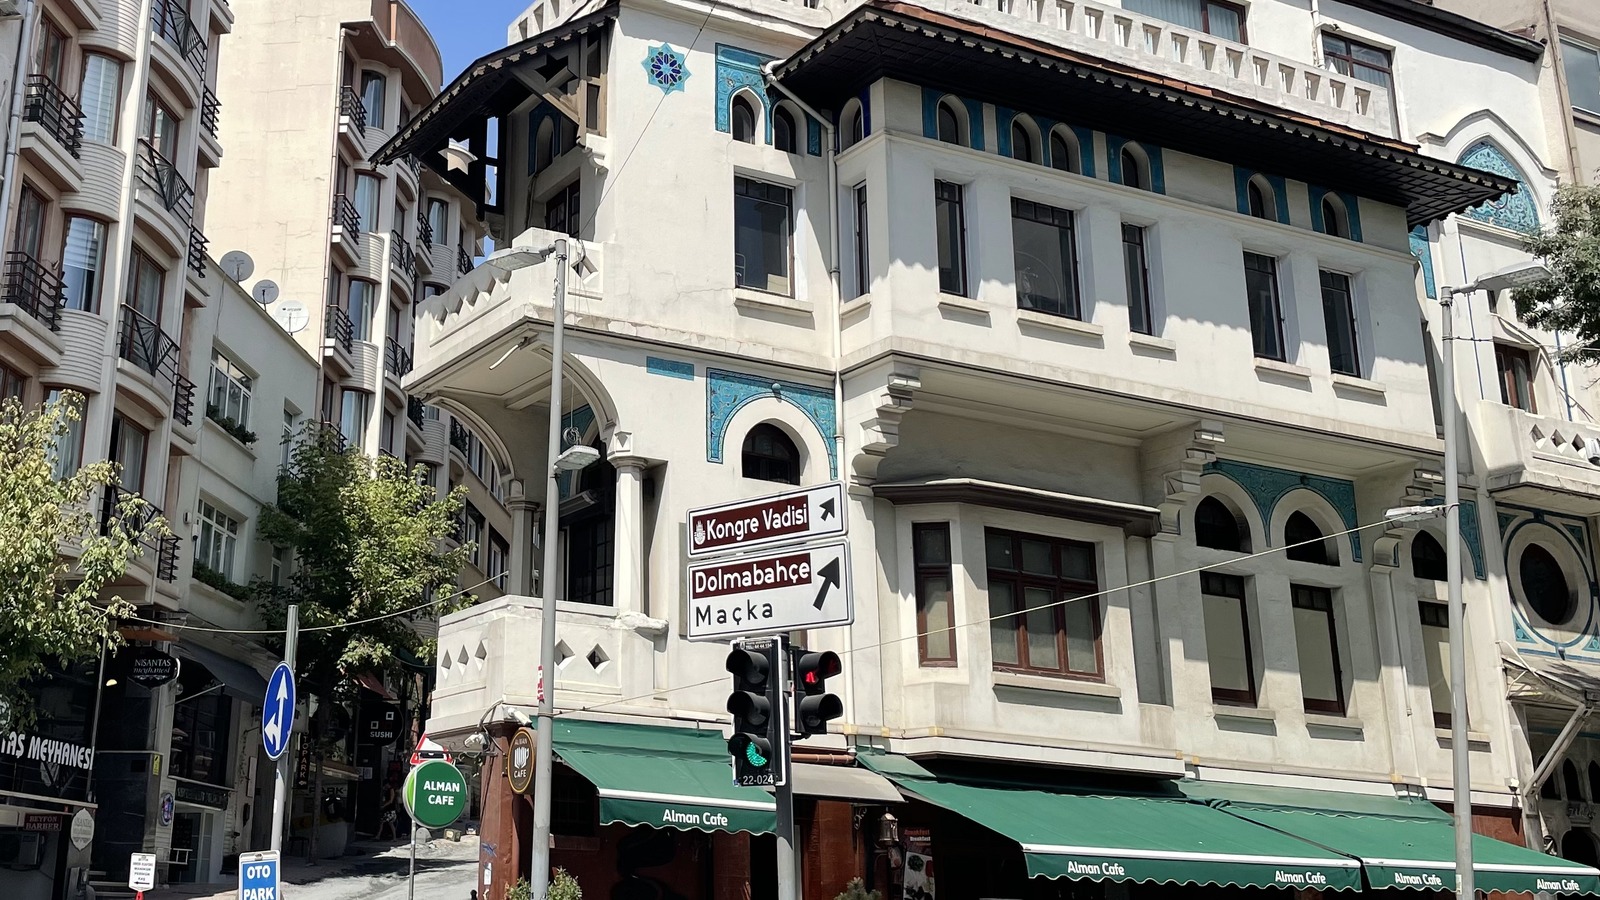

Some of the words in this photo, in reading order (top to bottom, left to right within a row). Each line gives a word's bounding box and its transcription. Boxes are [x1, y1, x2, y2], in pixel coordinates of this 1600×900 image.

[706, 517, 759, 541] Kongre
[762, 503, 807, 530] Vadisi
[695, 559, 810, 593] Dolmabahçe
[695, 599, 773, 627] Maçka
[513, 769, 527, 778] CAFE
[742, 774, 774, 785] 22-024
[423, 780, 460, 793] ALMAN
[428, 794, 455, 806] CAFE
[662, 809, 700, 824] Alman
[702, 812, 728, 827] Cafe
[25, 822, 60, 830] BARBER
[246, 864, 271, 880] OTO
[1067, 860, 1101, 875] Alman
[1101, 862, 1125, 876] Cafe
[1275, 870, 1304, 883] Alman
[1305, 871, 1326, 884] Cafe
[1394, 872, 1422, 885] Alman
[1422, 873, 1442, 886] Cafe
[1536, 878, 1562, 890] Alman
[1562, 879, 1580, 891] Cafe
[243, 886, 275, 900] PARK
